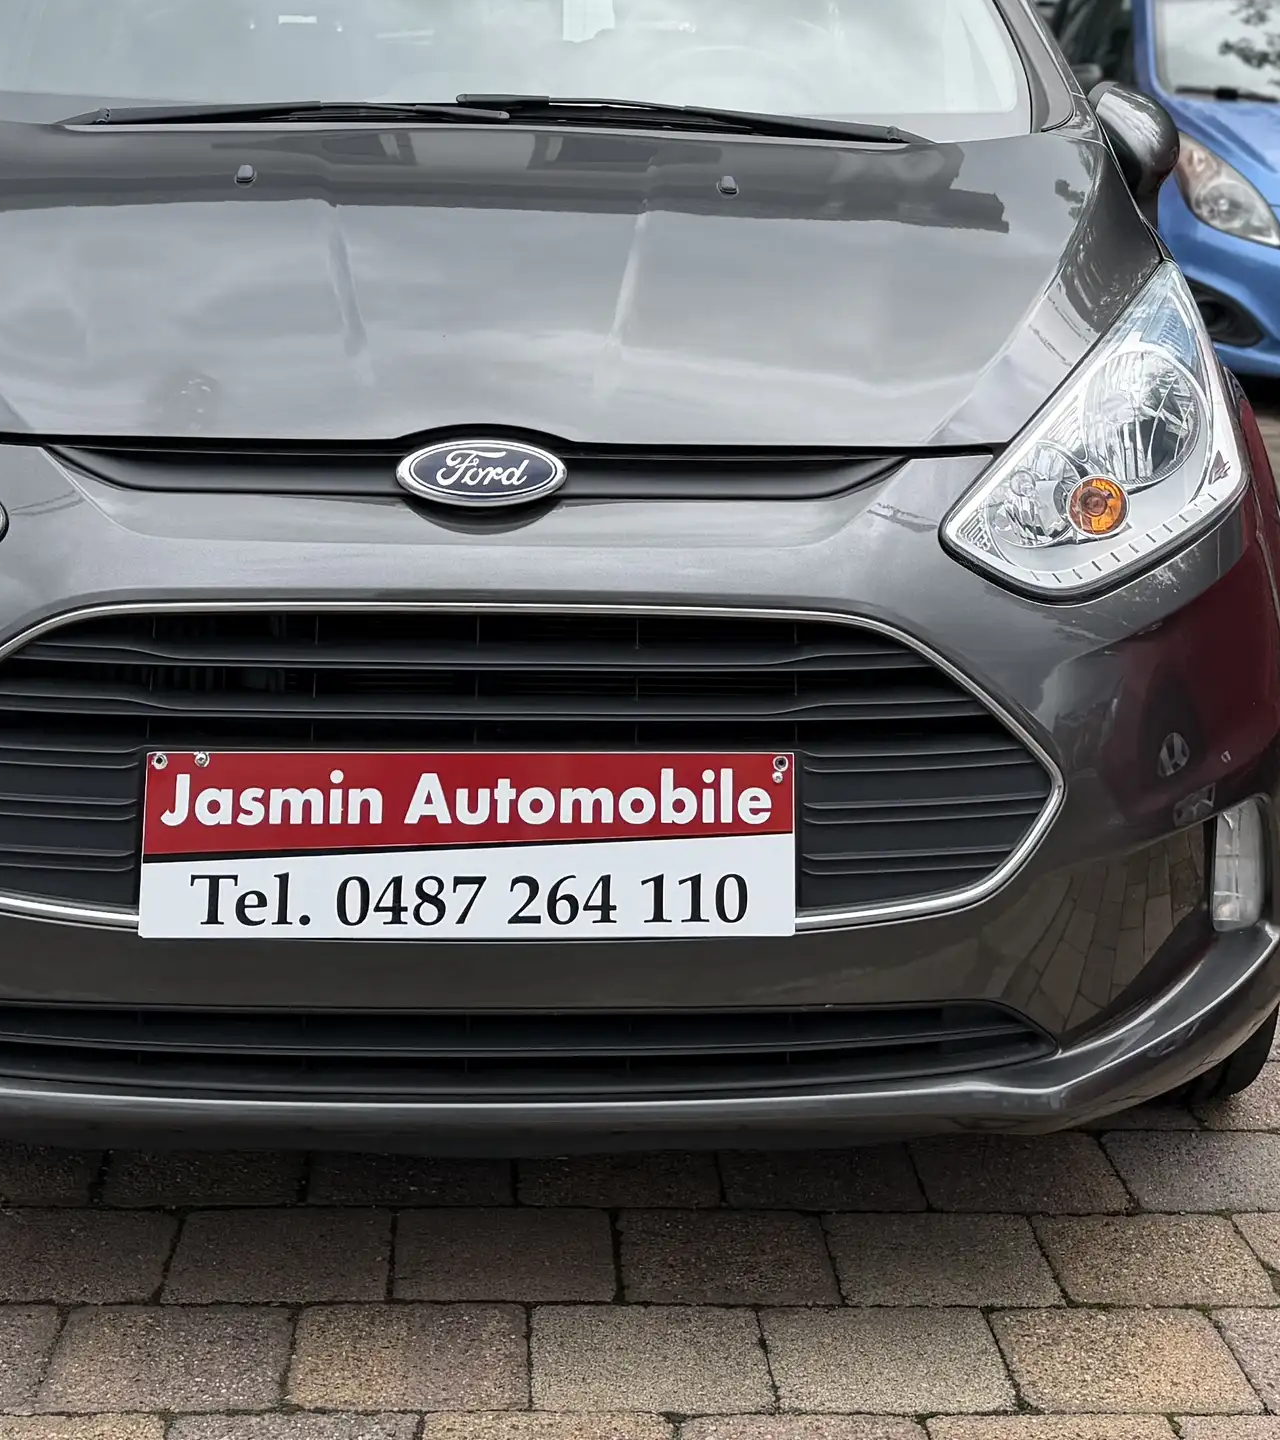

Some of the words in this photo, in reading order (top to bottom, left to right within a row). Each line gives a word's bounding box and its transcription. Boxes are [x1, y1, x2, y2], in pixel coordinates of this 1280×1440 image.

[436, 450, 529, 486] Ford
[160, 770, 383, 827] Jasmin
[404, 768, 773, 826] Automobile
[191, 873, 311, 927] Tel.
[336, 874, 487, 927] 0487
[507, 874, 617, 926] 264
[640, 872, 748, 925] 110
